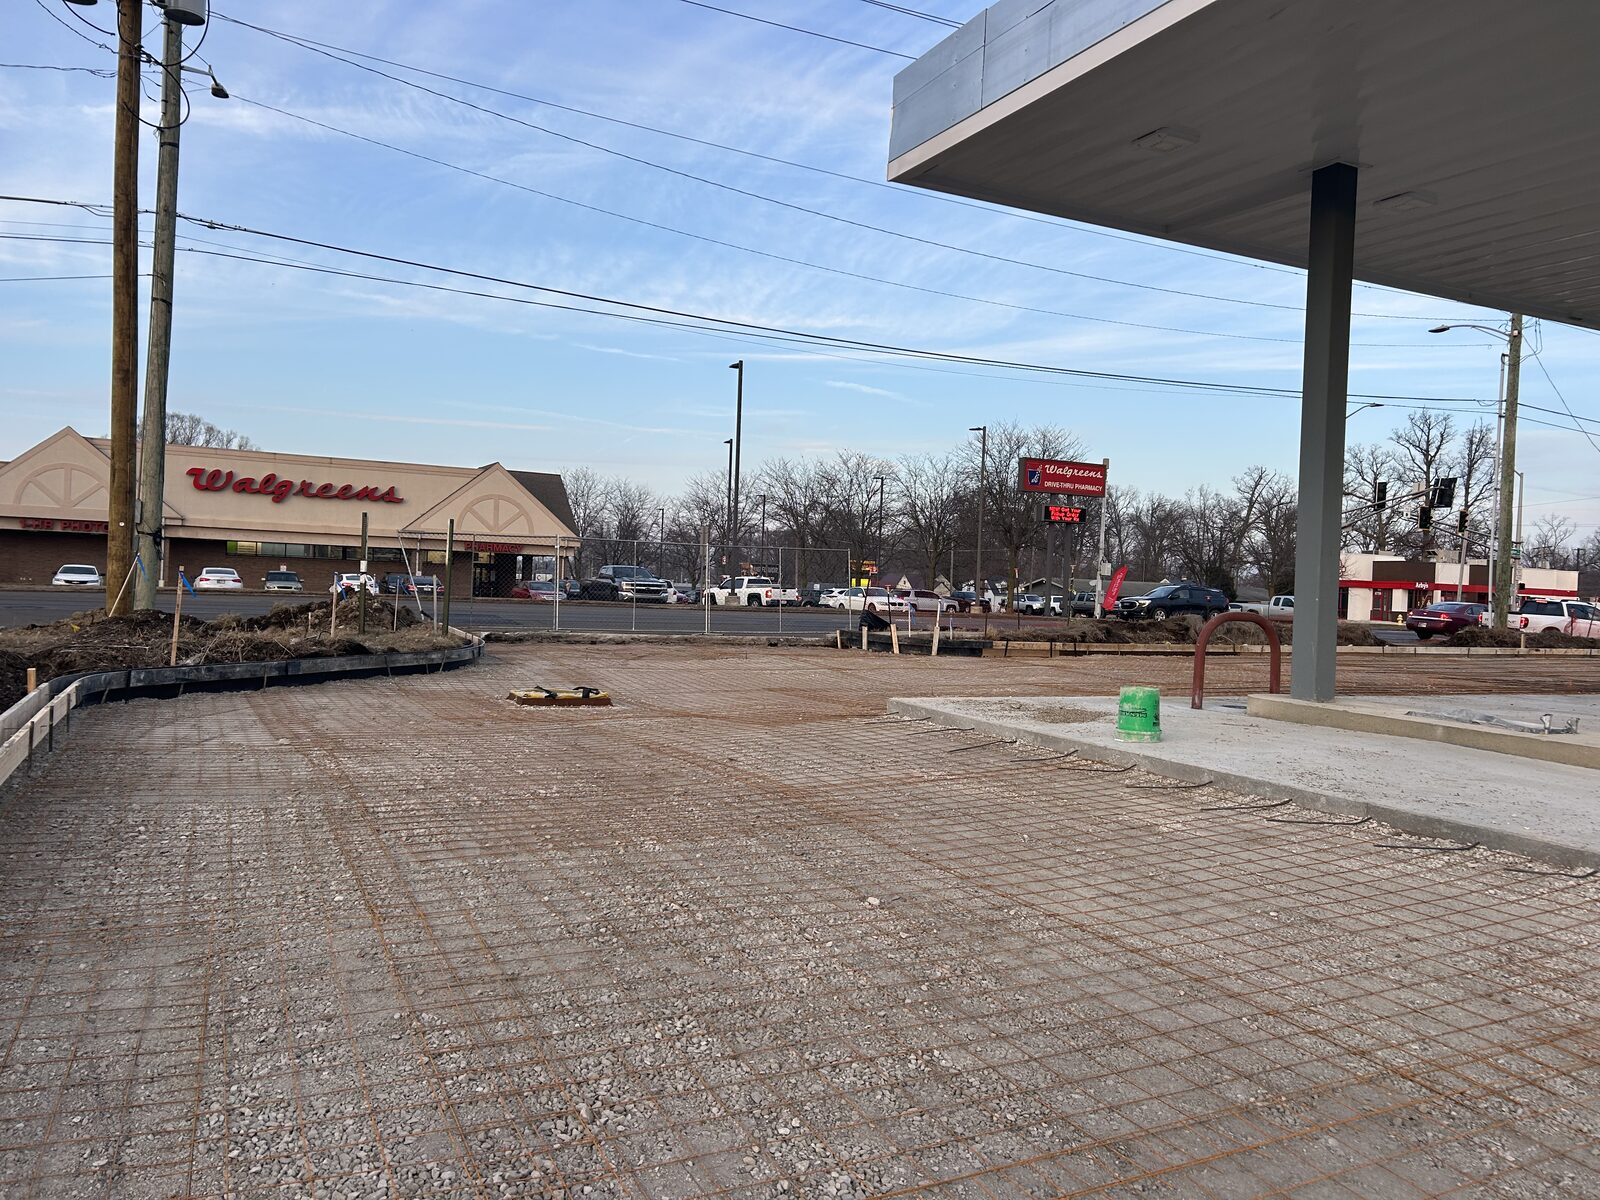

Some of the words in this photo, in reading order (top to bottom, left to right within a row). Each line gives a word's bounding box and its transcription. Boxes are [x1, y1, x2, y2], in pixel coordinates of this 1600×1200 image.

[1045, 464, 1103, 478] Walgreens
[186, 467, 404, 503] Walgreens
[1044, 481, 1074, 489] DRIVE-THRU
[1074, 483, 1102, 492] PHARMACY
[19, 519, 53, 529] 1-HR
[464, 542, 523, 553] PHARMACY
[1415, 582, 1429, 590] Arby's
